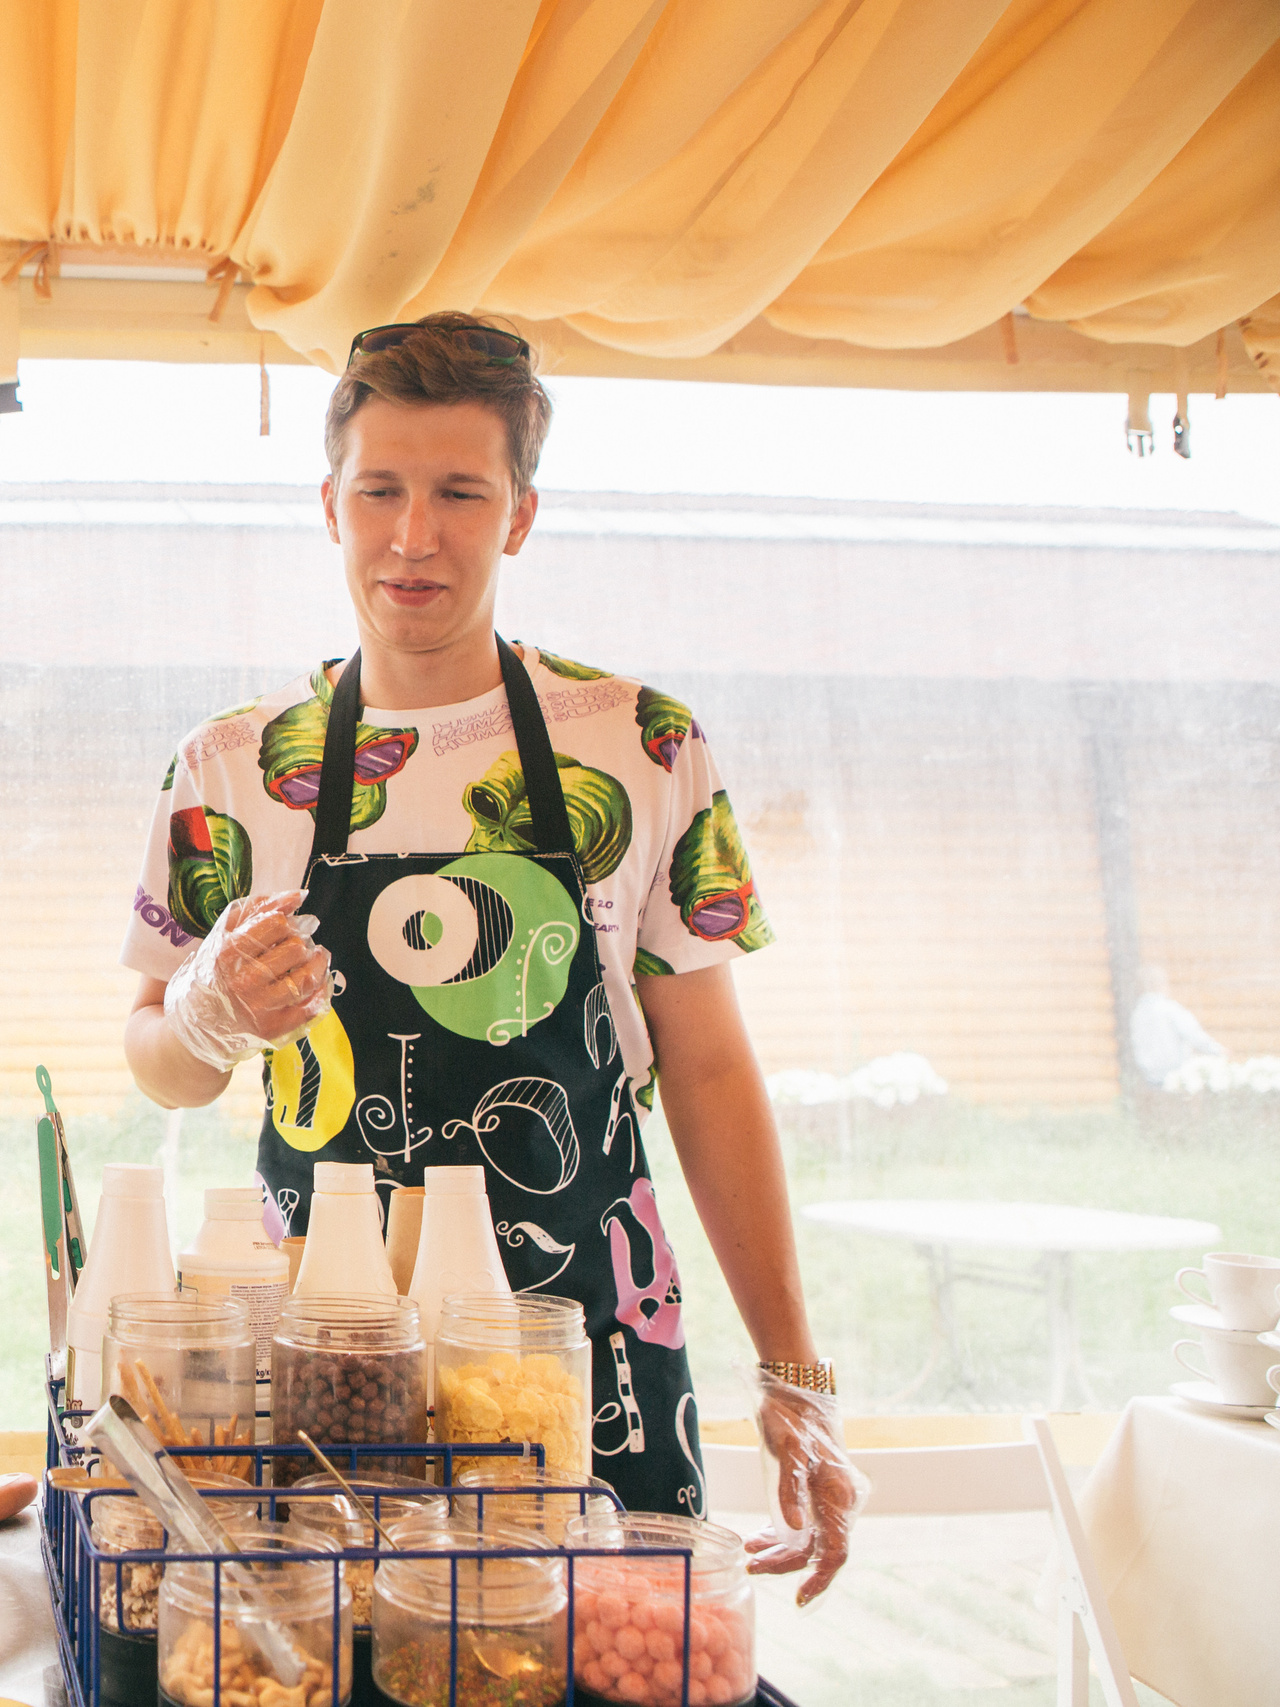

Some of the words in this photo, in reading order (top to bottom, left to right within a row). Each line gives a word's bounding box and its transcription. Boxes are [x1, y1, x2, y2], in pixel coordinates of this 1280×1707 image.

[551, 685, 629, 712] SUCK
[553, 691, 633, 722] SUCK
[134, 884, 195, 947] ION
[598, 900, 613, 909] 2.0
